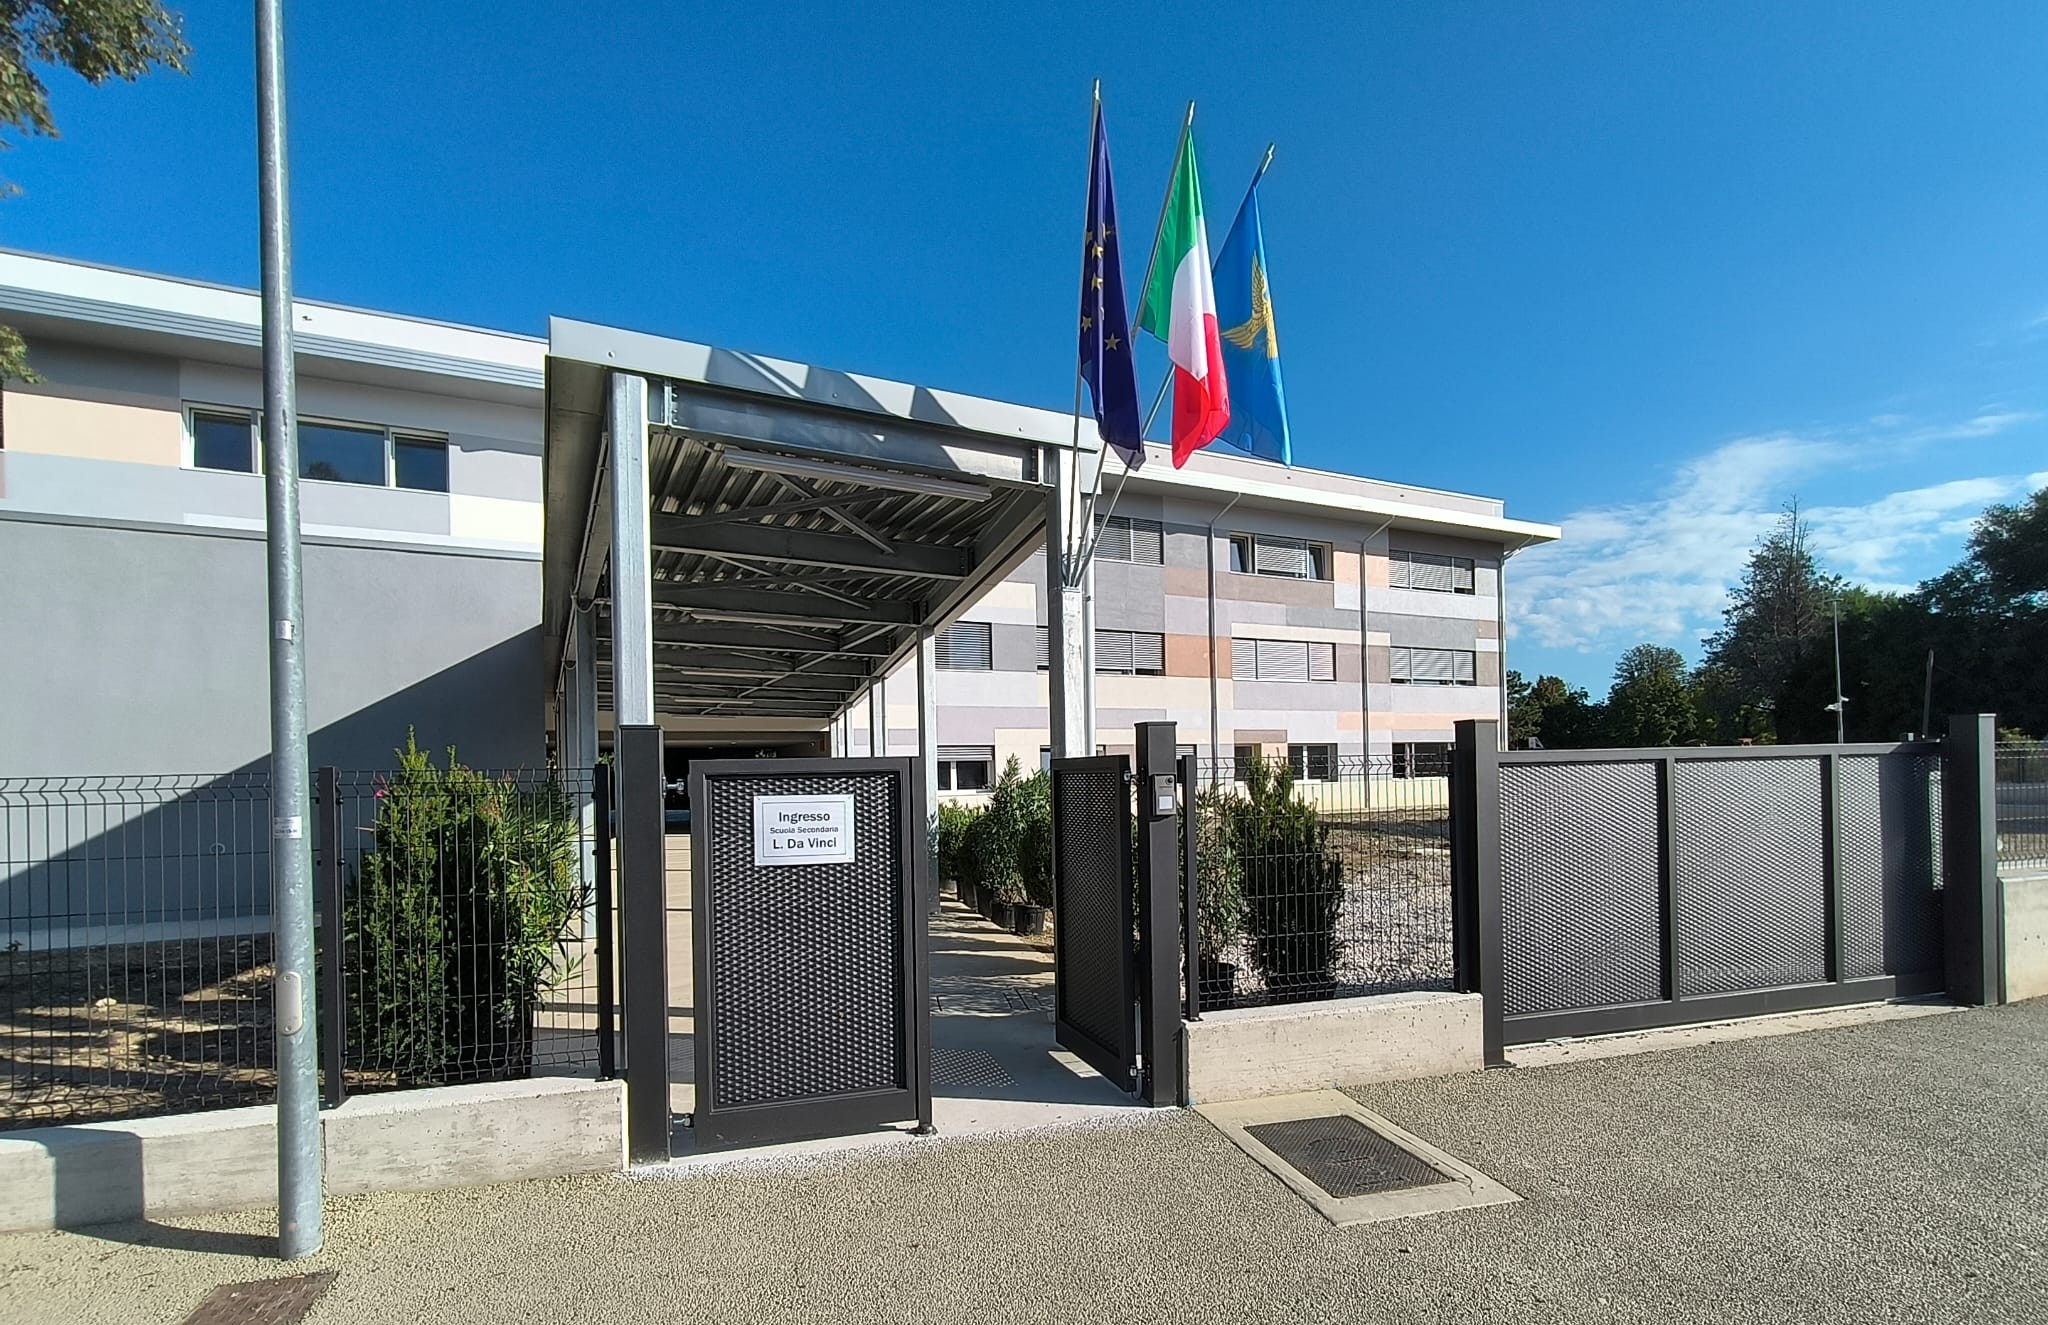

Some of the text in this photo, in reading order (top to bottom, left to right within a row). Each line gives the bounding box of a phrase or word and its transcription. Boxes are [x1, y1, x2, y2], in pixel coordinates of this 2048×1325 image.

[779, 812, 830, 824] Ingresso
[797, 826, 839, 834] Secondaria
[773, 837, 837, 849] L. Da Vinci
